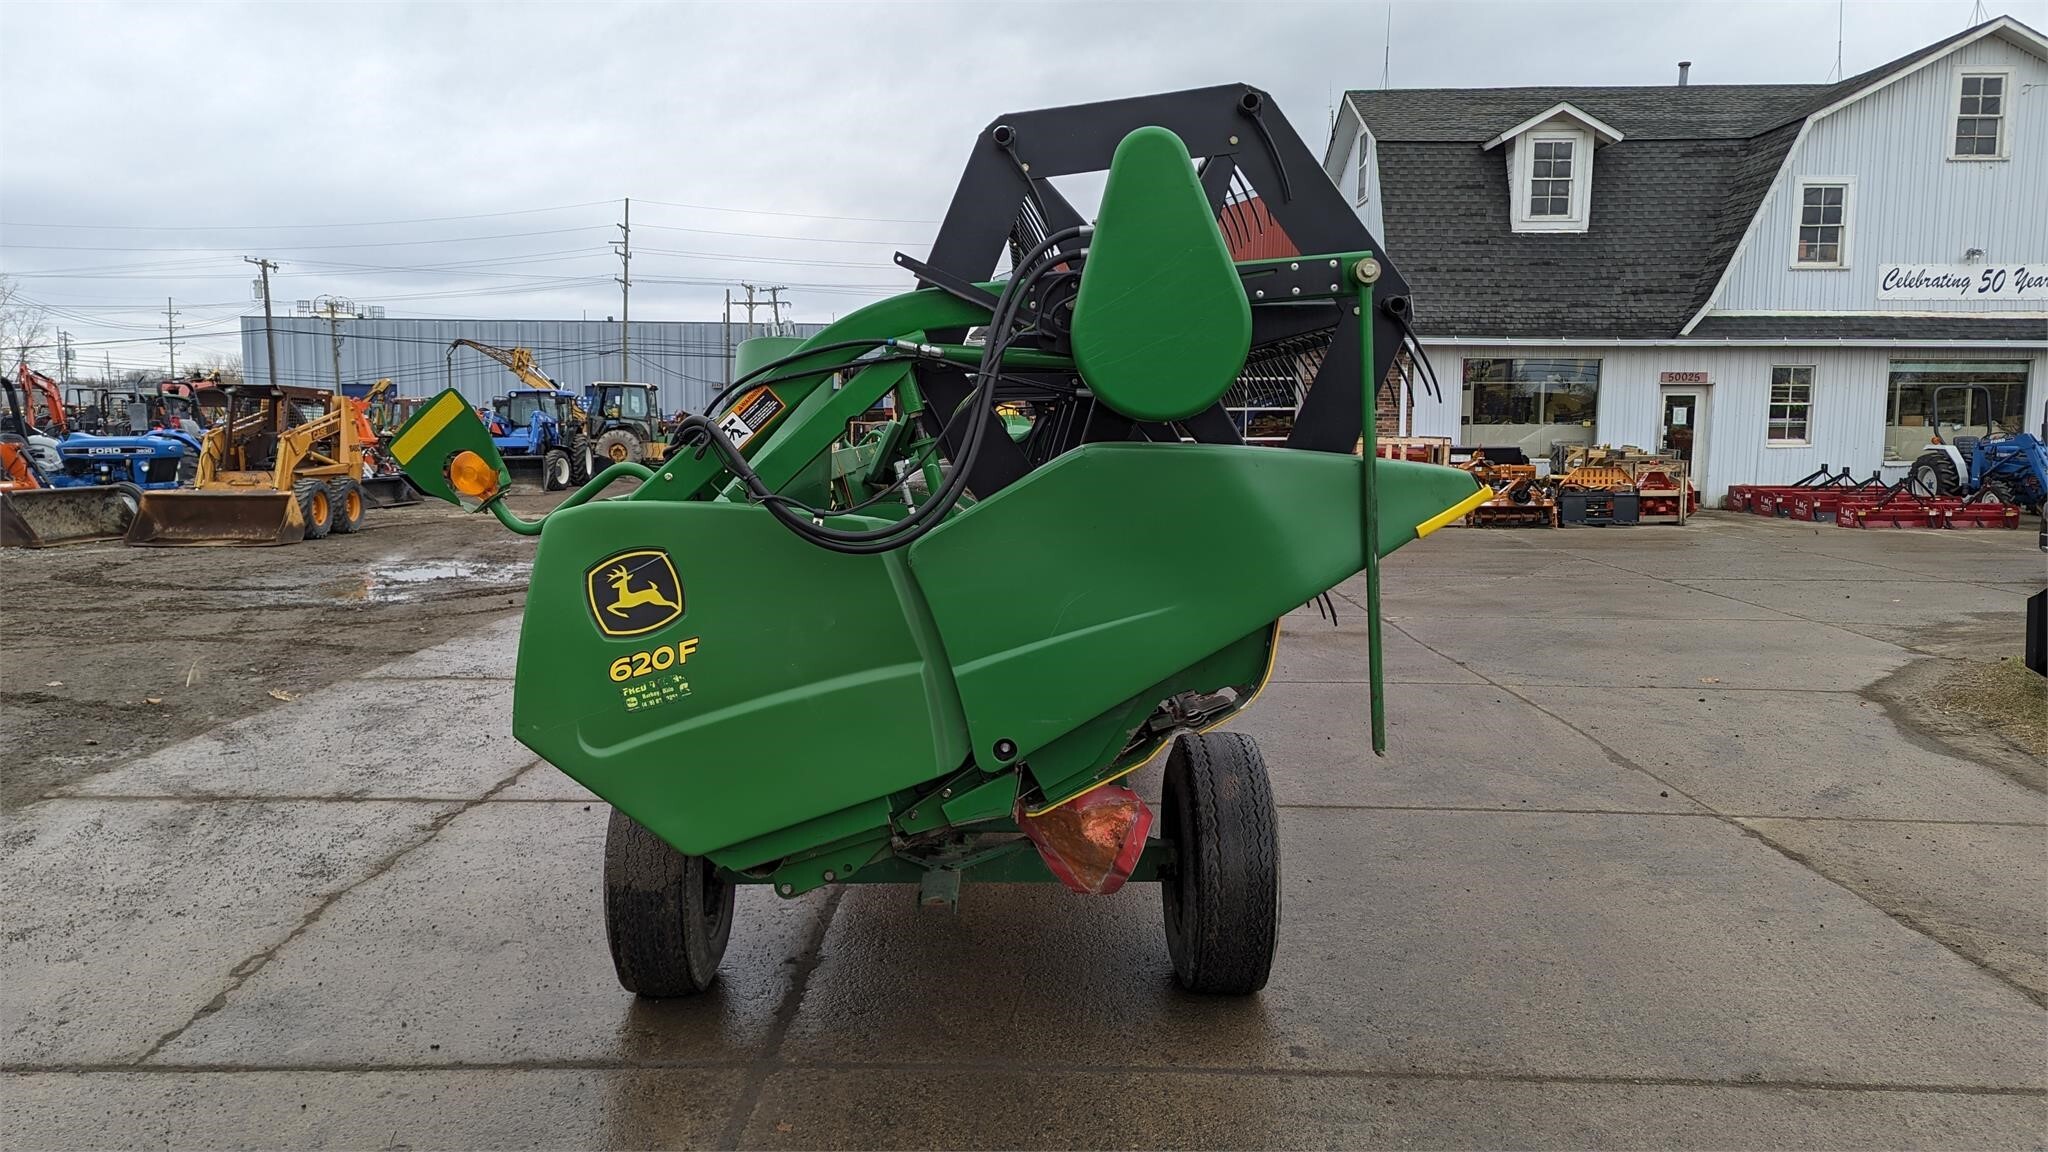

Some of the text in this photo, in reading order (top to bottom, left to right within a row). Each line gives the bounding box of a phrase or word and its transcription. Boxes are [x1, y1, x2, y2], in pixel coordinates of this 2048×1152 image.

[1882, 267, 1971, 295] Celebrating
[1978, 269, 2006, 294] 50
[1669, 372, 1700, 382] 50025
[88, 447, 121, 455] FORD
[1841, 506, 1854, 519] LMC
[609, 637, 699, 682] 620F
